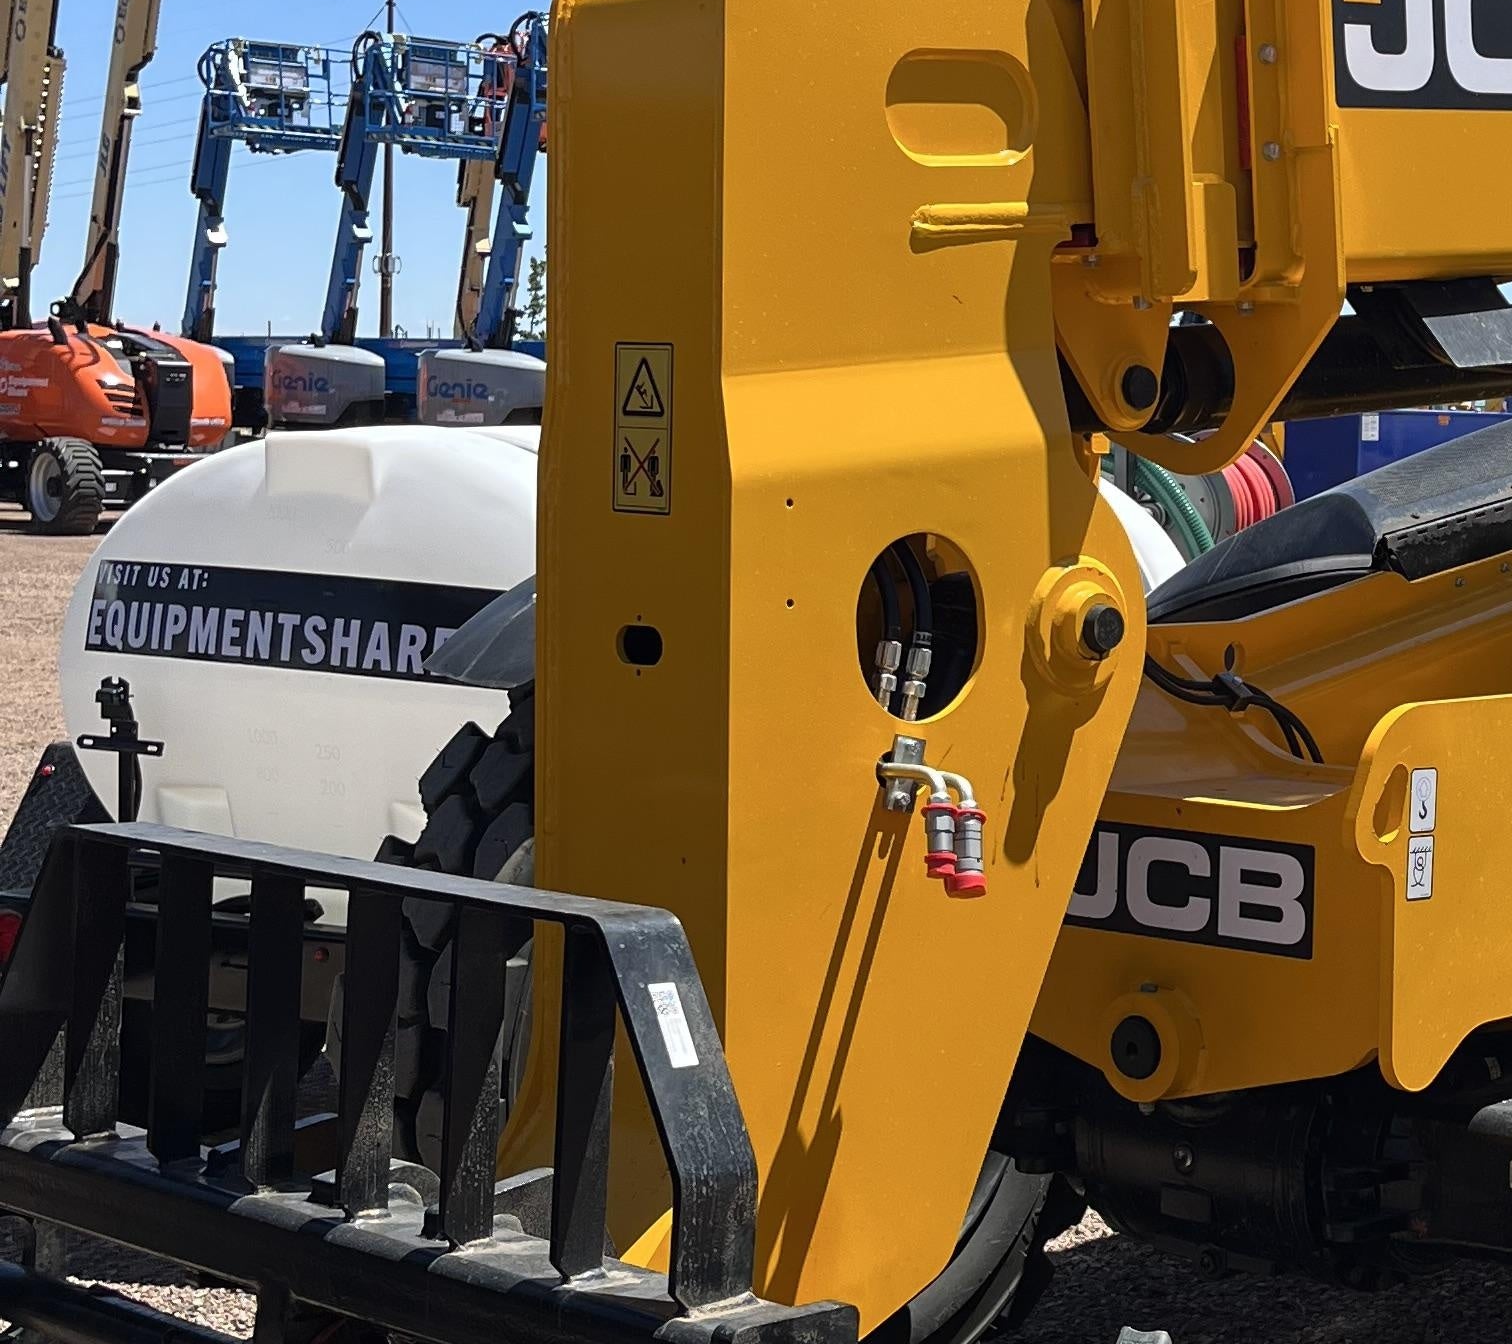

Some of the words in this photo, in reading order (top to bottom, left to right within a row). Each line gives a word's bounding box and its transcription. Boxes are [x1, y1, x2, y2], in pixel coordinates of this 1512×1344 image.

[271, 369, 330, 392] Genie
[427, 375, 488, 400] Genie
[99, 561, 142, 587] VISIT
[147, 566, 171, 588] US
[178, 568, 209, 590] AT:
[1067, 831, 1306, 946] JCB
